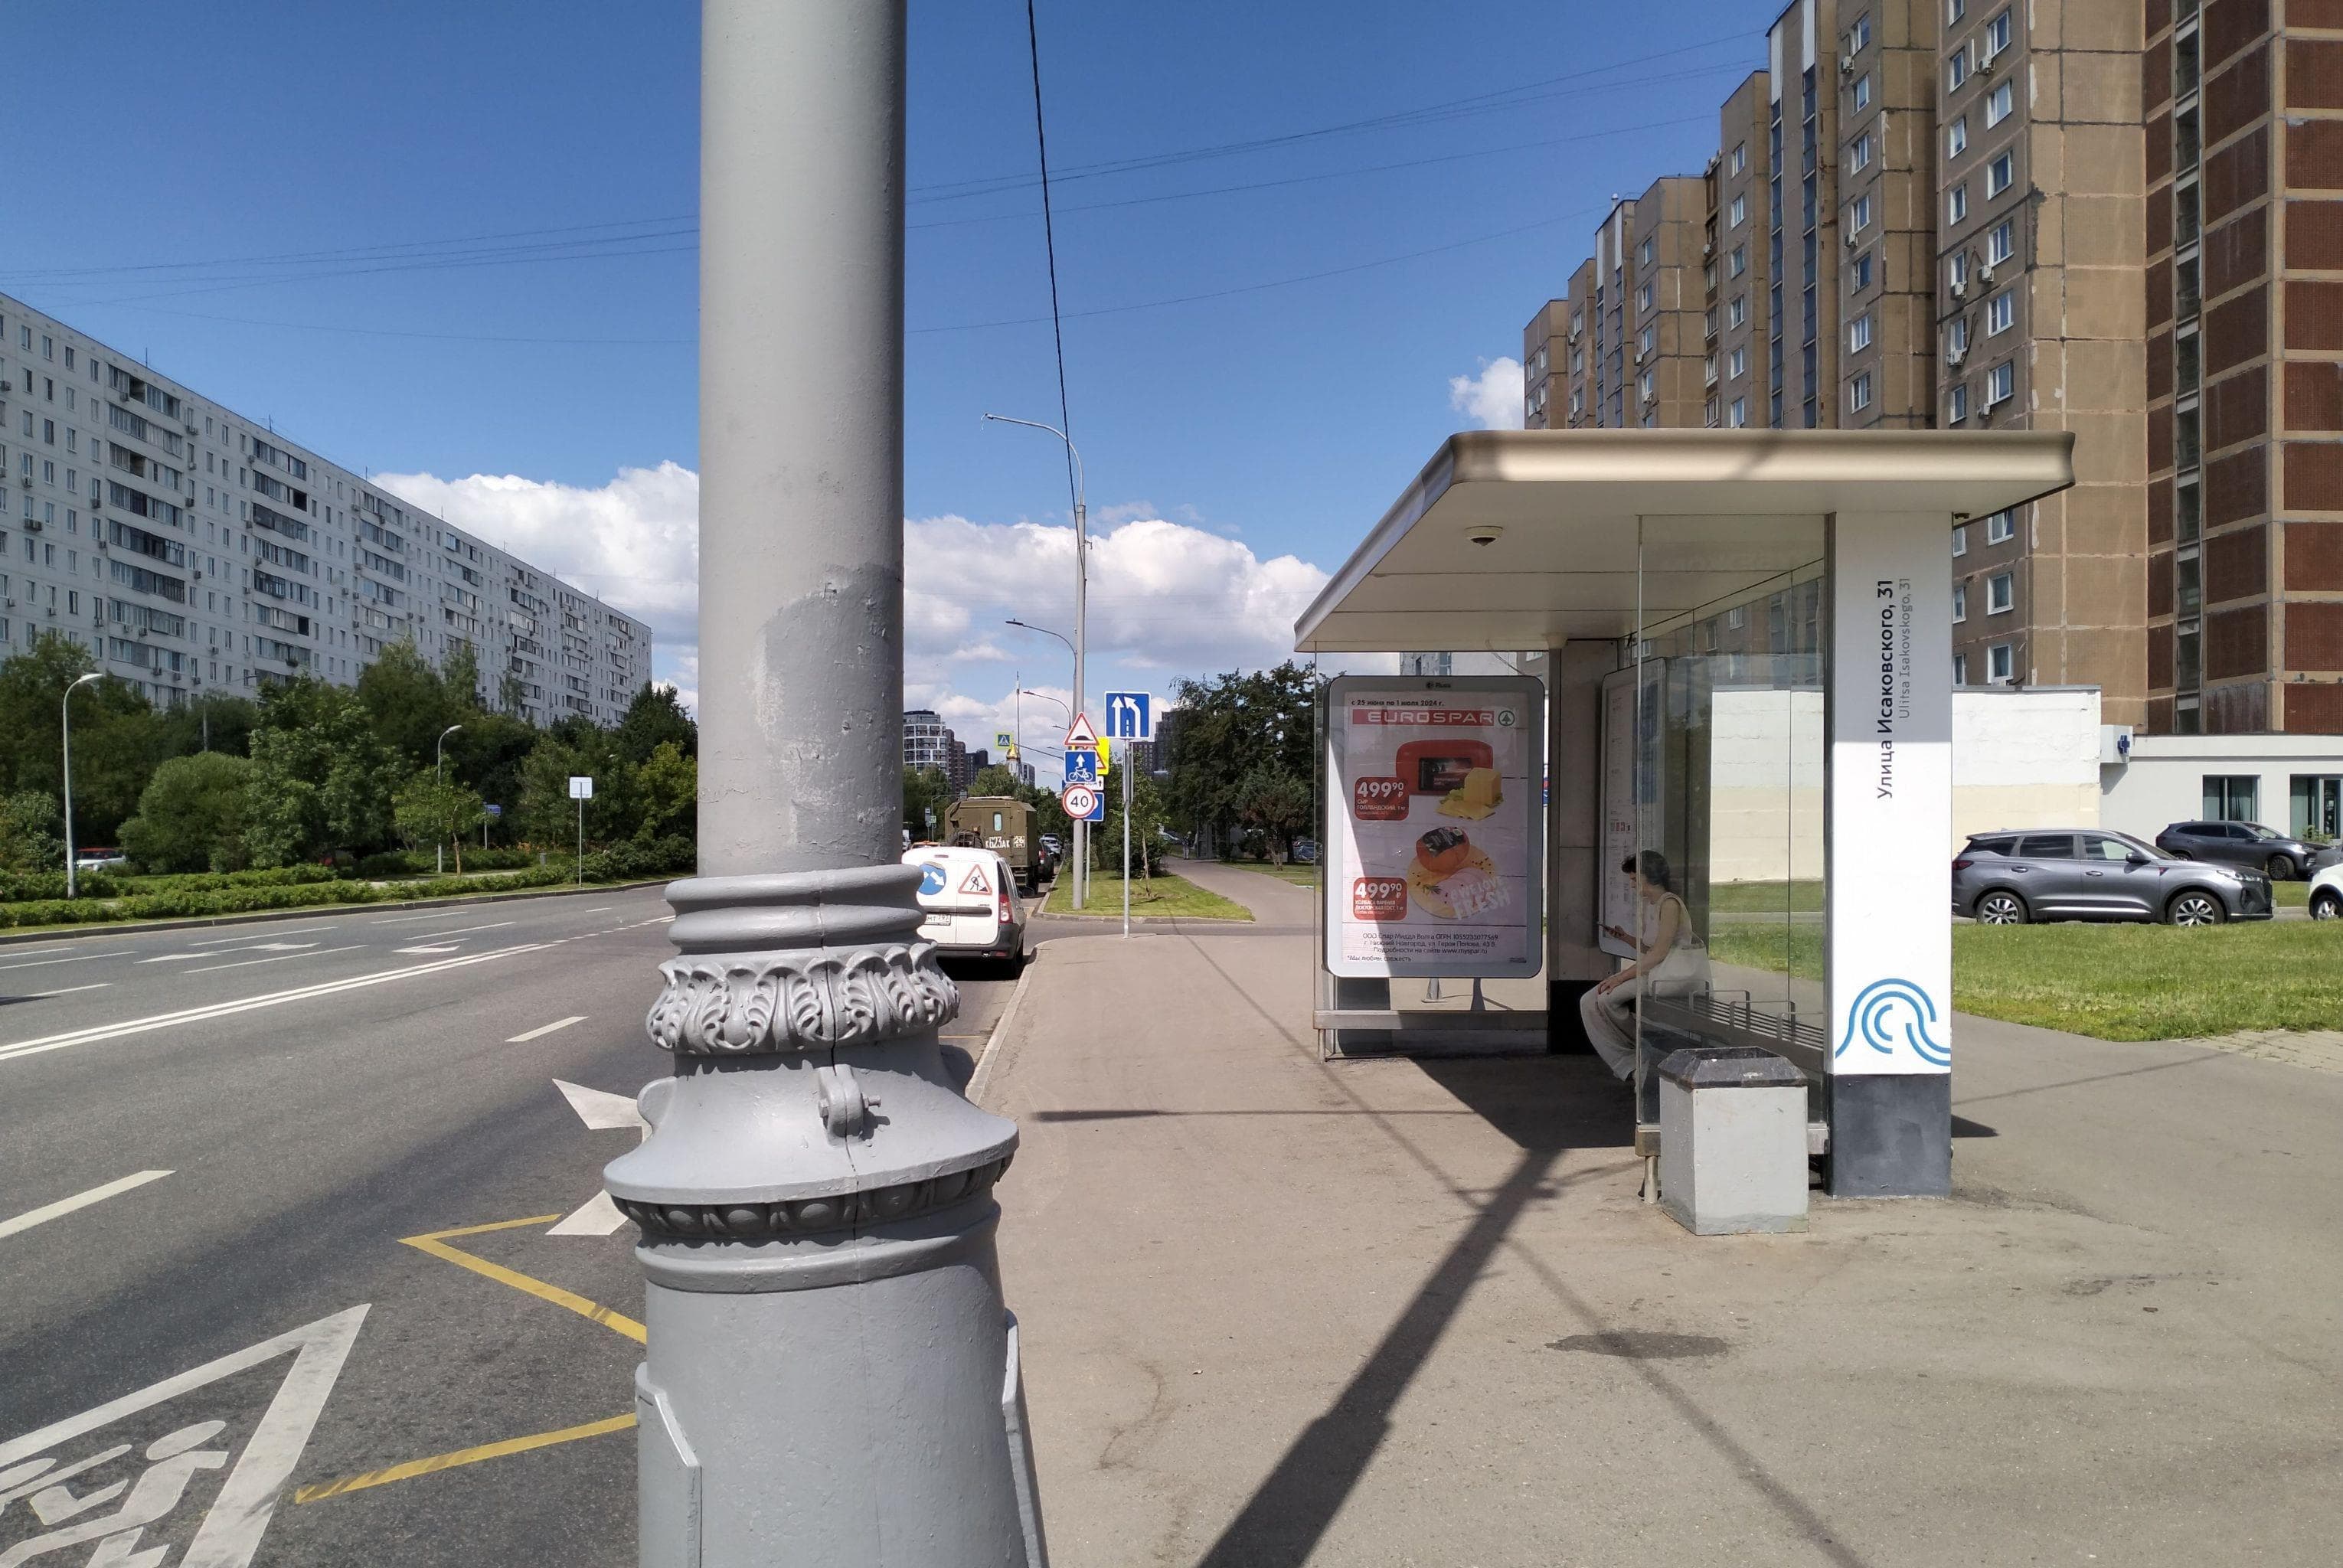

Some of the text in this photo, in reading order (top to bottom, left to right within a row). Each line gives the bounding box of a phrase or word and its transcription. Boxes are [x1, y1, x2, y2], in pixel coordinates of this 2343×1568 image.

[1899, 578, 1913, 718] Ulitsa Isakovskogo, 31
[1368, 711, 1493, 724] EUROSPAR
[1877, 580, 1896, 799] Улица Исаковского, 31
[1070, 795, 1089, 808] 40
